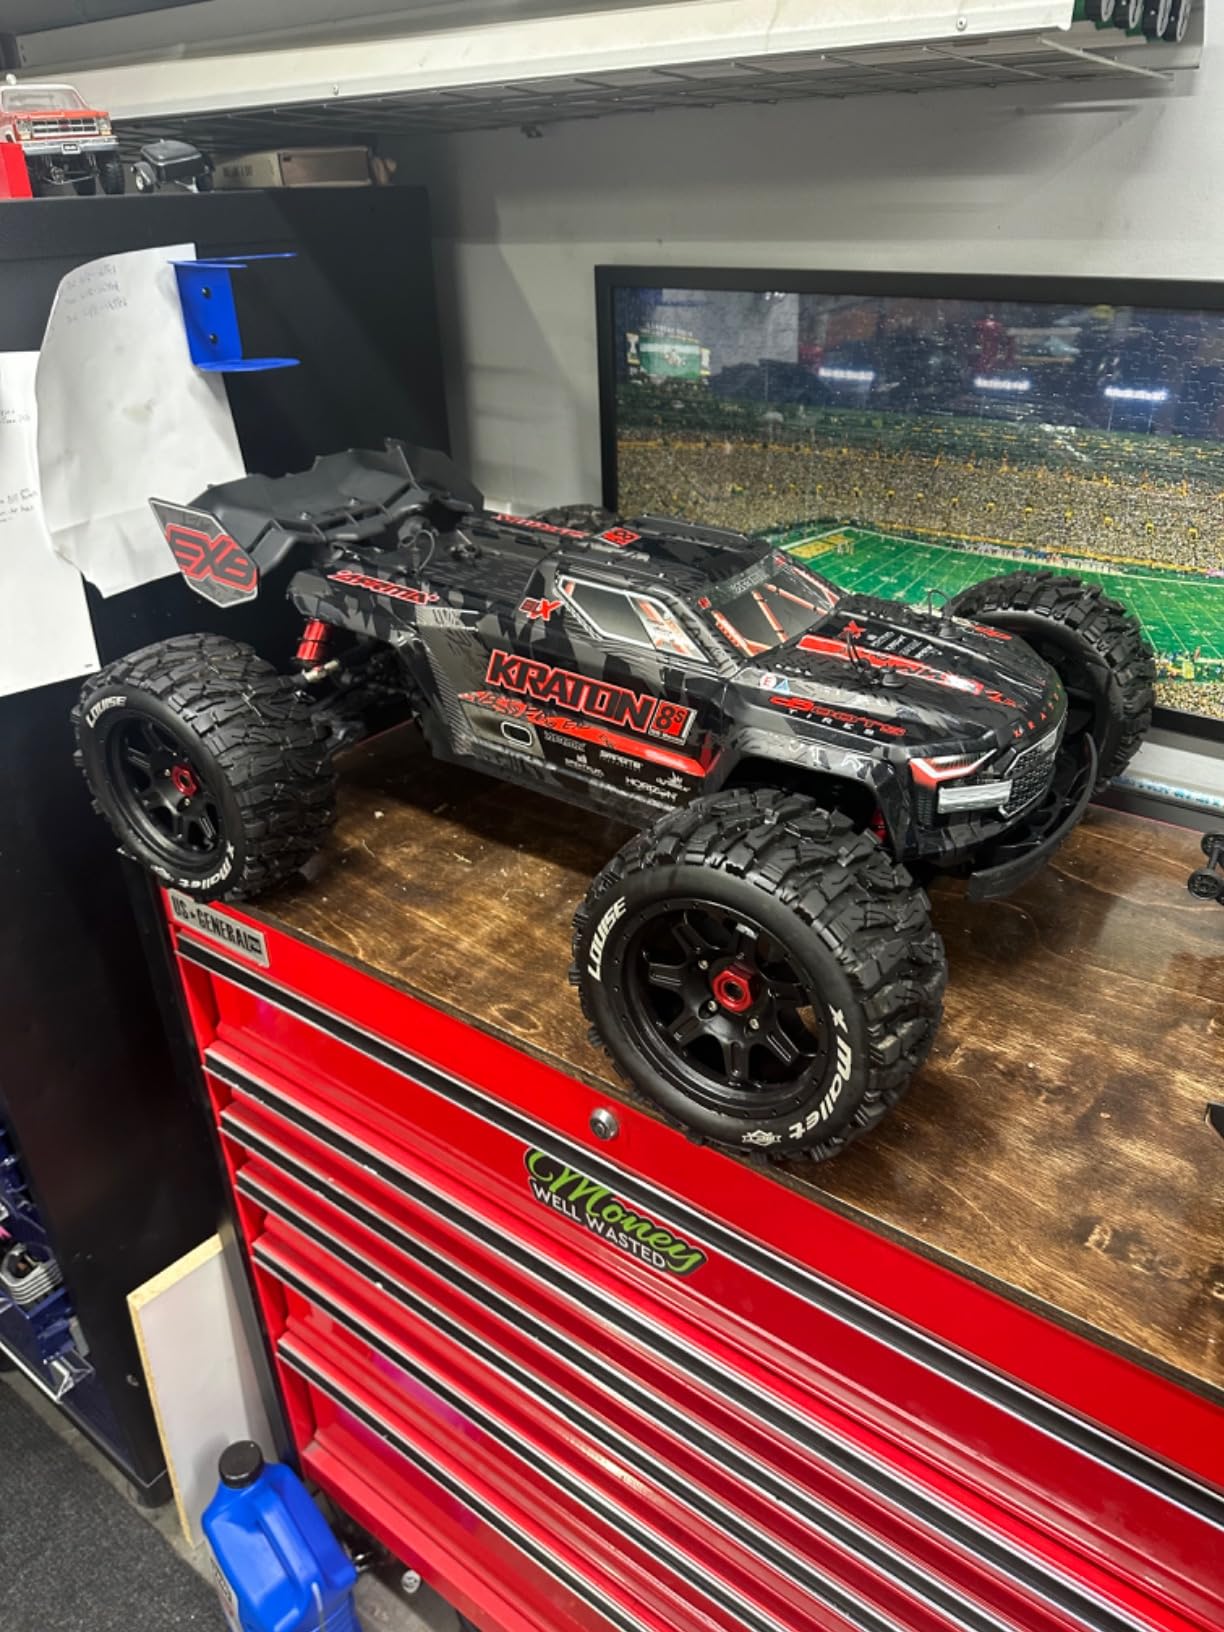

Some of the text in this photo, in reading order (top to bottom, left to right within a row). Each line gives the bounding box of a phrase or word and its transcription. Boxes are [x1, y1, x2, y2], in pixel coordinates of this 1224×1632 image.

[86, 695, 127, 728] LOUISE
[485, 649, 658, 733] KRATON
[196, 907, 252, 952] GENERAL
[588, 896, 627, 982] LOUISE
[528, 1150, 704, 1273] Money
[532, 1183, 666, 1269] WELL WASTED
